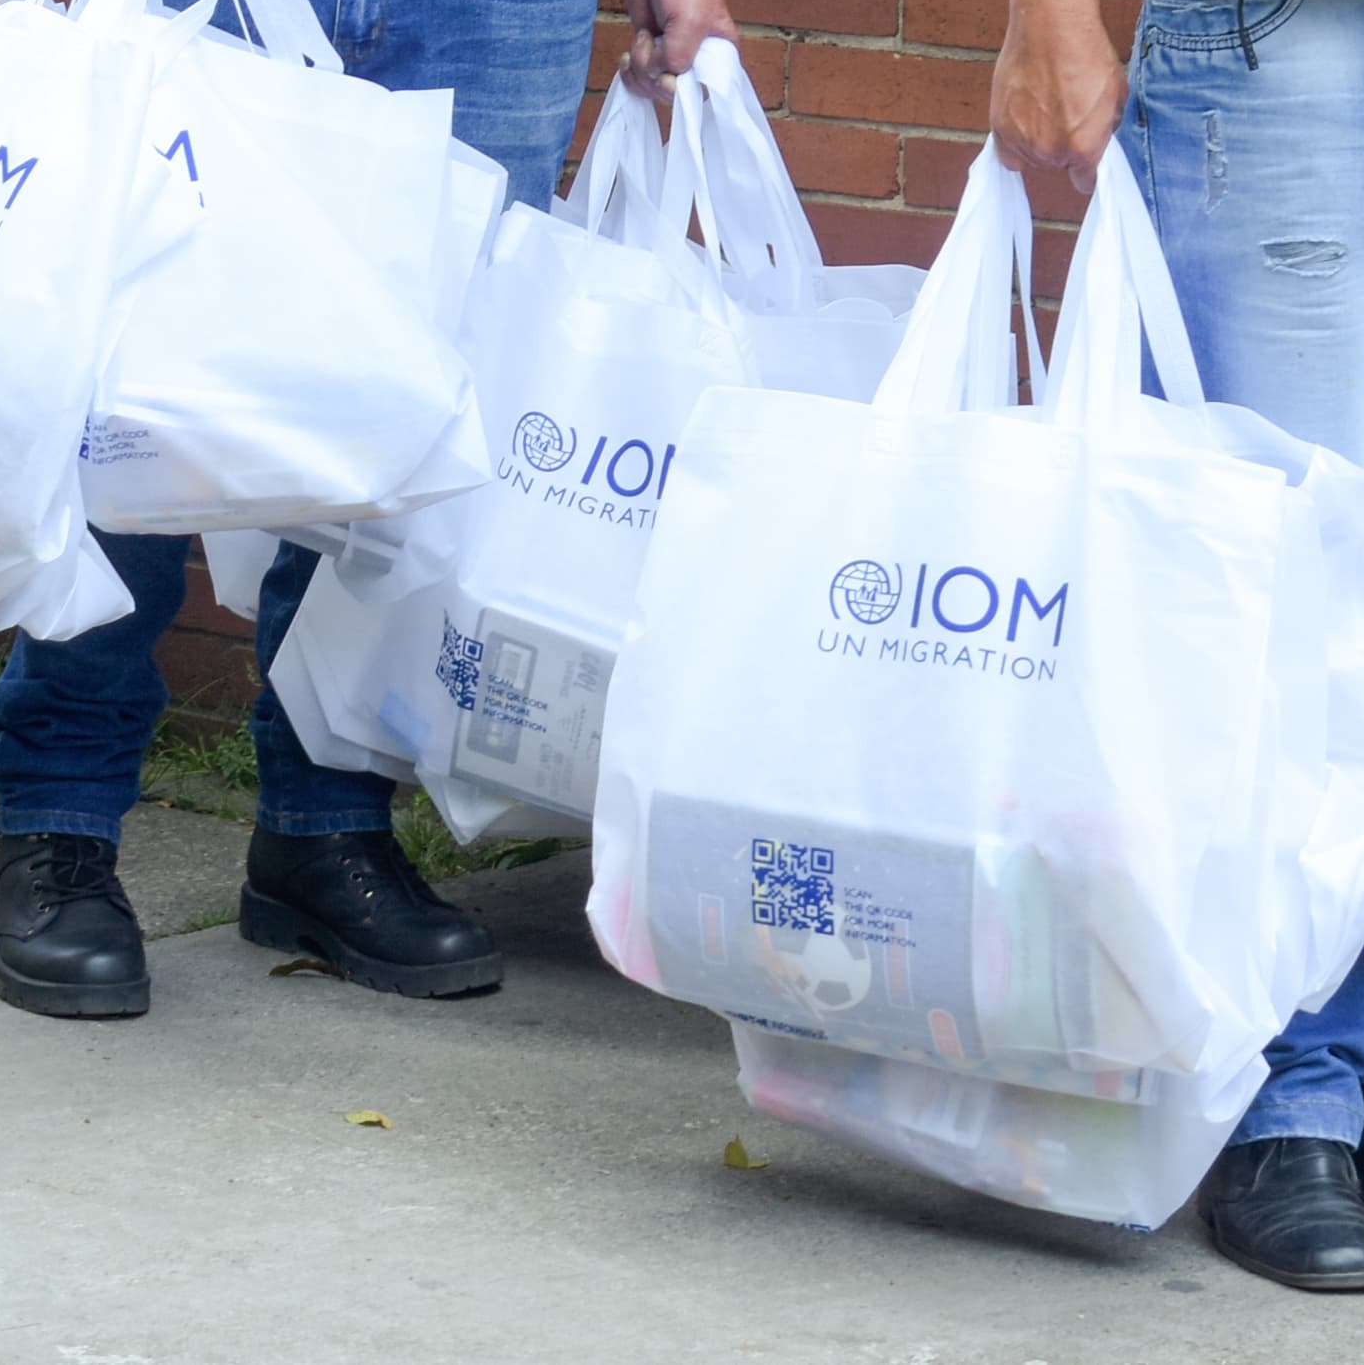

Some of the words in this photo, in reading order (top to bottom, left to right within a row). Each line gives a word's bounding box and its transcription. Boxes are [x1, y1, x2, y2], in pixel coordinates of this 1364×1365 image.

[497, 457, 534, 494] UN
[543, 485, 658, 530] MIGRATI
[910, 563, 1069, 648] IOM
[818, 629, 866, 657] UN
[879, 638, 1057, 682] MIGRATION
[482, 707, 547, 733] INFORMATION
[844, 929, 916, 948] INFORMATION
